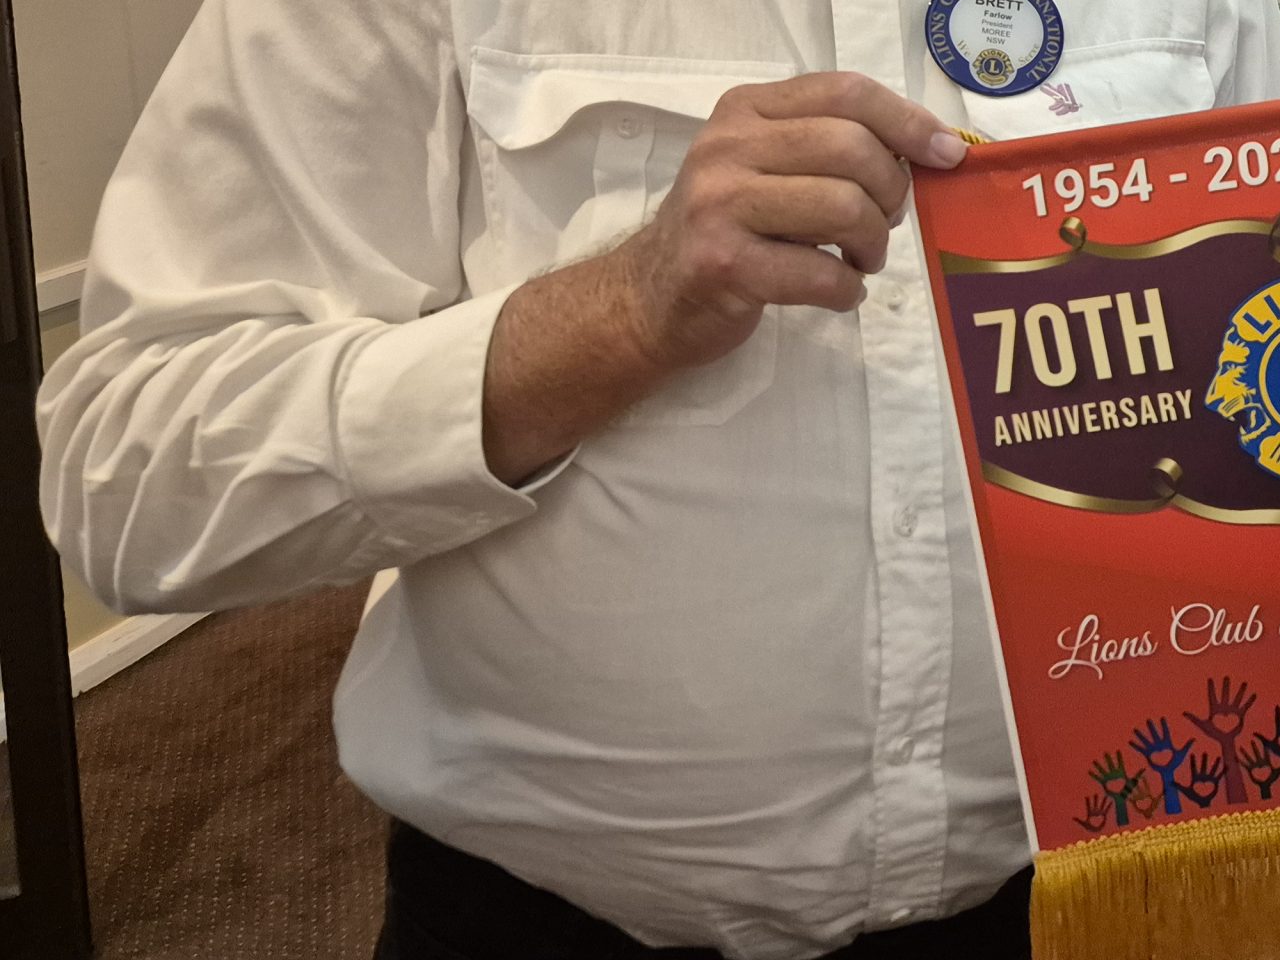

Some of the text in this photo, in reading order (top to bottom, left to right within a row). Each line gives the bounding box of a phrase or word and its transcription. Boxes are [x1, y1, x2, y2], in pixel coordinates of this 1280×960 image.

[981, 19, 1013, 30] President
[984, 10, 1012, 21] Farlow
[931, 12, 955, 65] LIONS
[982, 27, 1011, 38] MOREE
[986, 36, 1005, 46] NSW
[989, 60, 1000, 73] L
[1022, 158, 1153, 217] 1954
[973, 287, 1175, 394] 70TH
[994, 389, 1193, 448] ANNIVERSARY
[1048, 614, 1157, 681] Lions
[1169, 602, 1264, 655] Club
